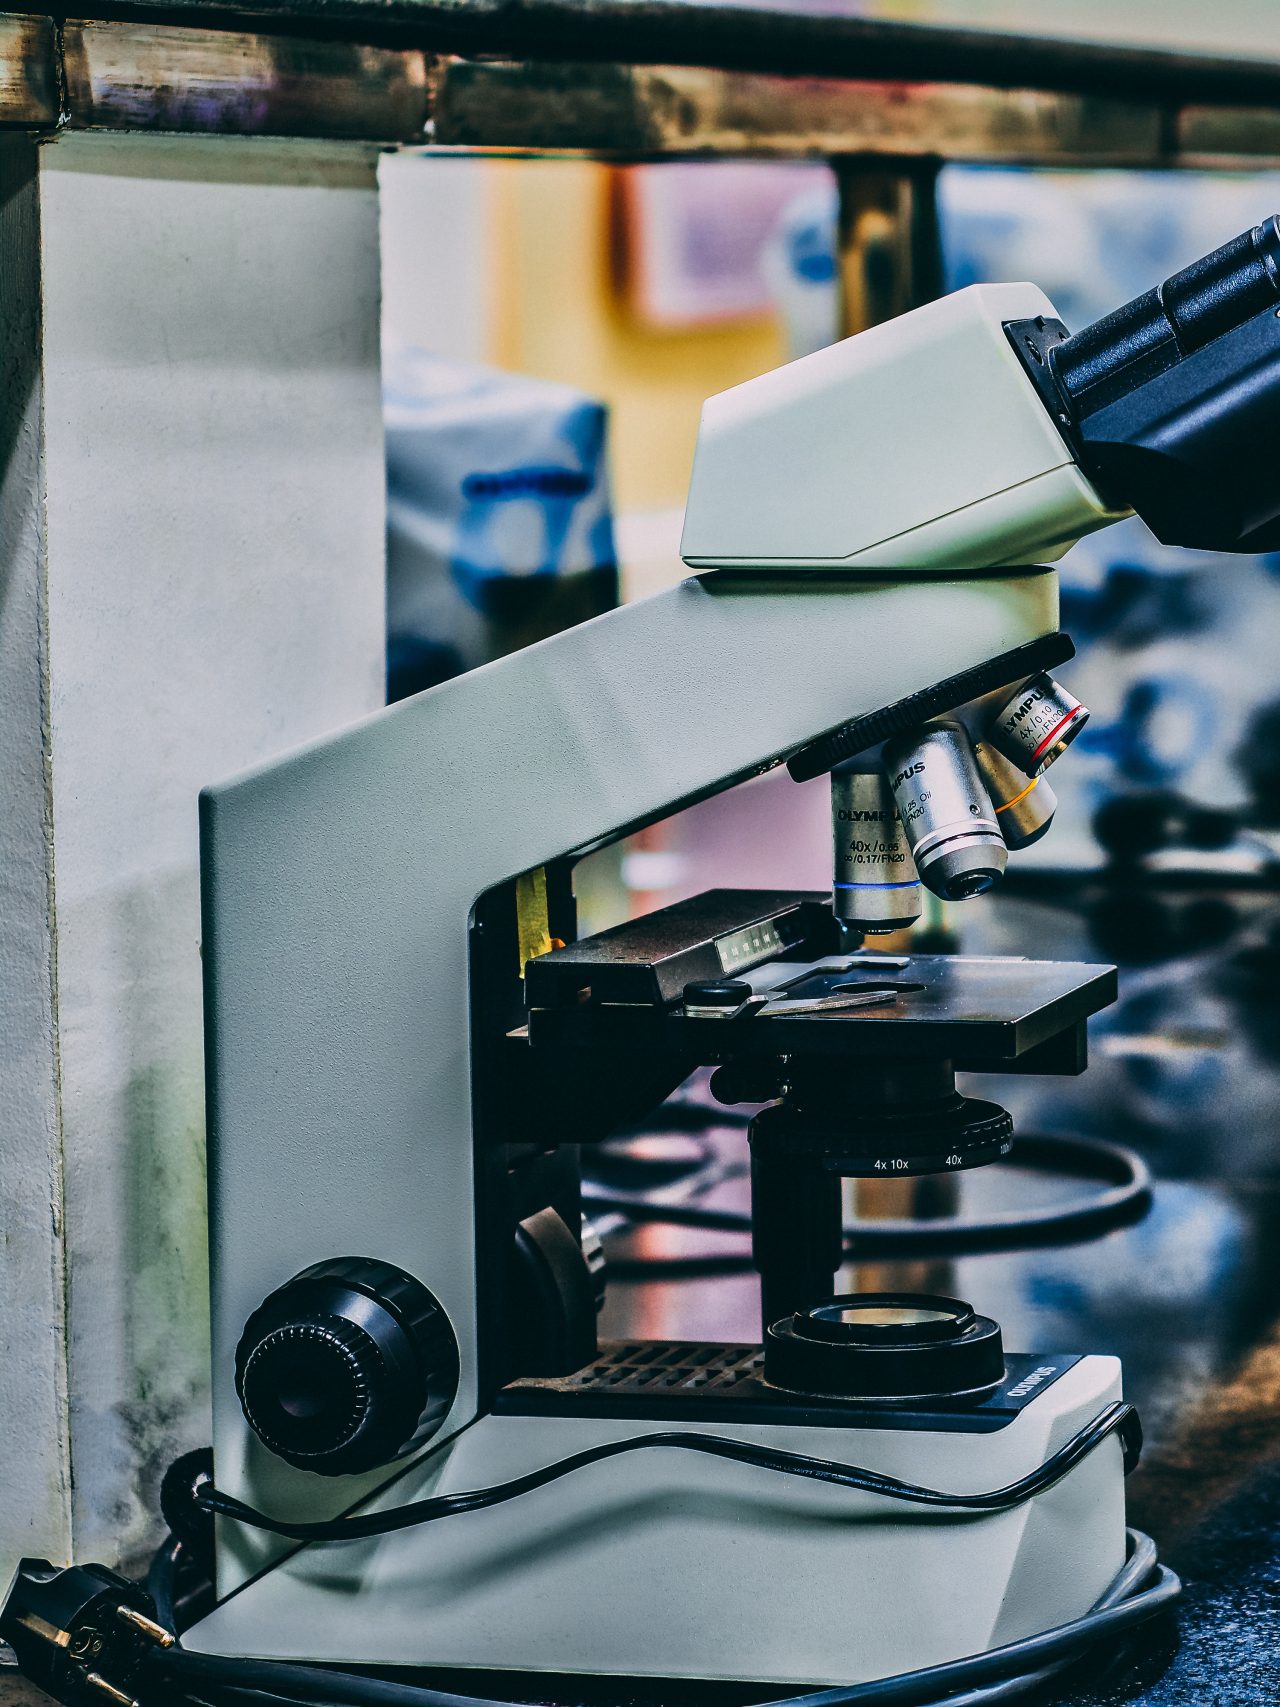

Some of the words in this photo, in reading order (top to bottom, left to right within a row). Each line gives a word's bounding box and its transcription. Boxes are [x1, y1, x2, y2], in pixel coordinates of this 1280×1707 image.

[874, 1160, 887, 1170] 4x
[891, 1159, 909, 1169] 10x
[945, 1155, 962, 1166] 40x
[1007, 1366, 1057, 1397] OLYMPUS
